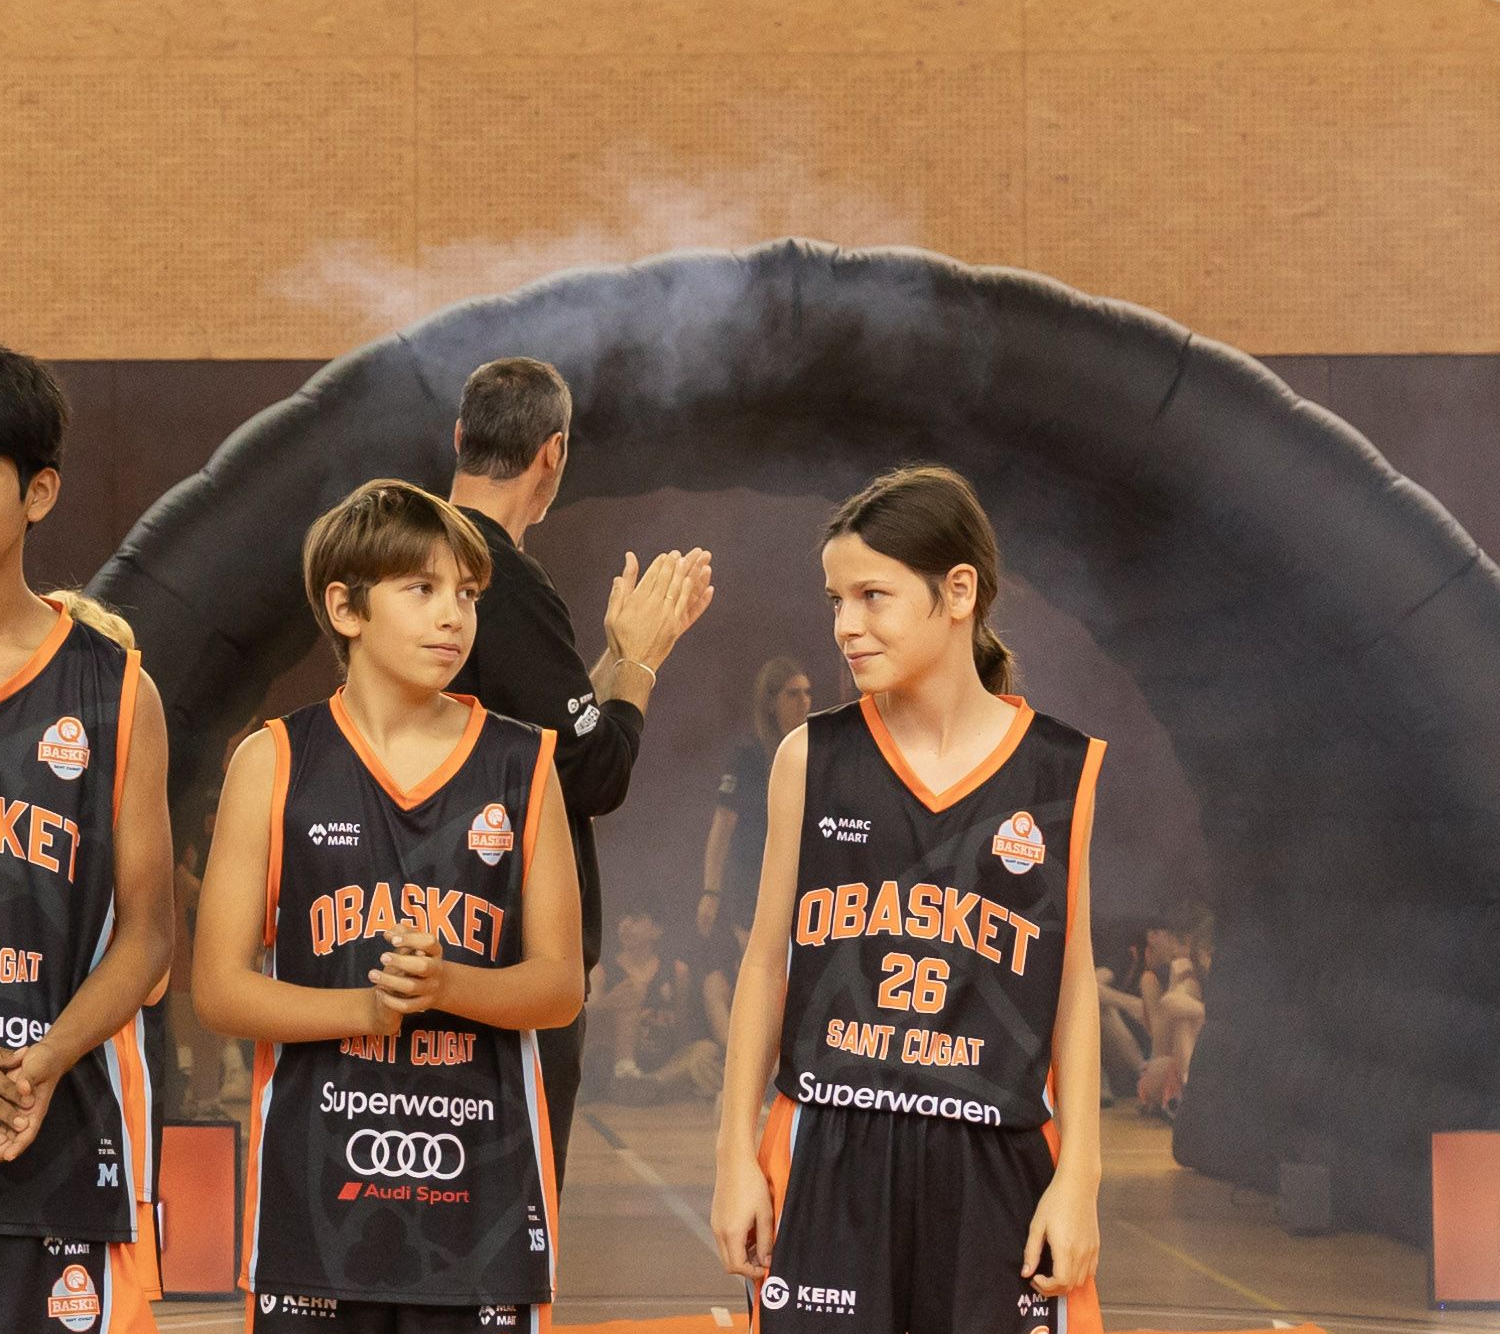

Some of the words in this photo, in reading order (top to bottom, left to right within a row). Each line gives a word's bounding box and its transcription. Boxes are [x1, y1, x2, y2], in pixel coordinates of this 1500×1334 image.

[327, 822, 361, 834] MARC
[838, 817, 872, 831] MARC
[327, 835, 360, 847] MART
[836, 830, 869, 844] MART
[996, 838, 1042, 859] BASKET
[309, 881, 505, 962] QBASKET
[795, 880, 1041, 977] QBASKET
[877, 951, 951, 1015] 26
[339, 1031, 401, 1064] SANT
[410, 1029, 476, 1066] CUGAT
[826, 1018, 896, 1061] SANT
[900, 1027, 985, 1067] CUGAT
[320, 1080, 494, 1127] Superwagen
[97, 1163, 119, 1187] M
[363, 1183, 412, 1201] Audi
[416, 1185, 470, 1205] Sport
[797, 1284, 857, 1307] KERN
[282, 1306, 337, 1318] PHARMA
[796, 1302, 856, 1315] PHARMA
